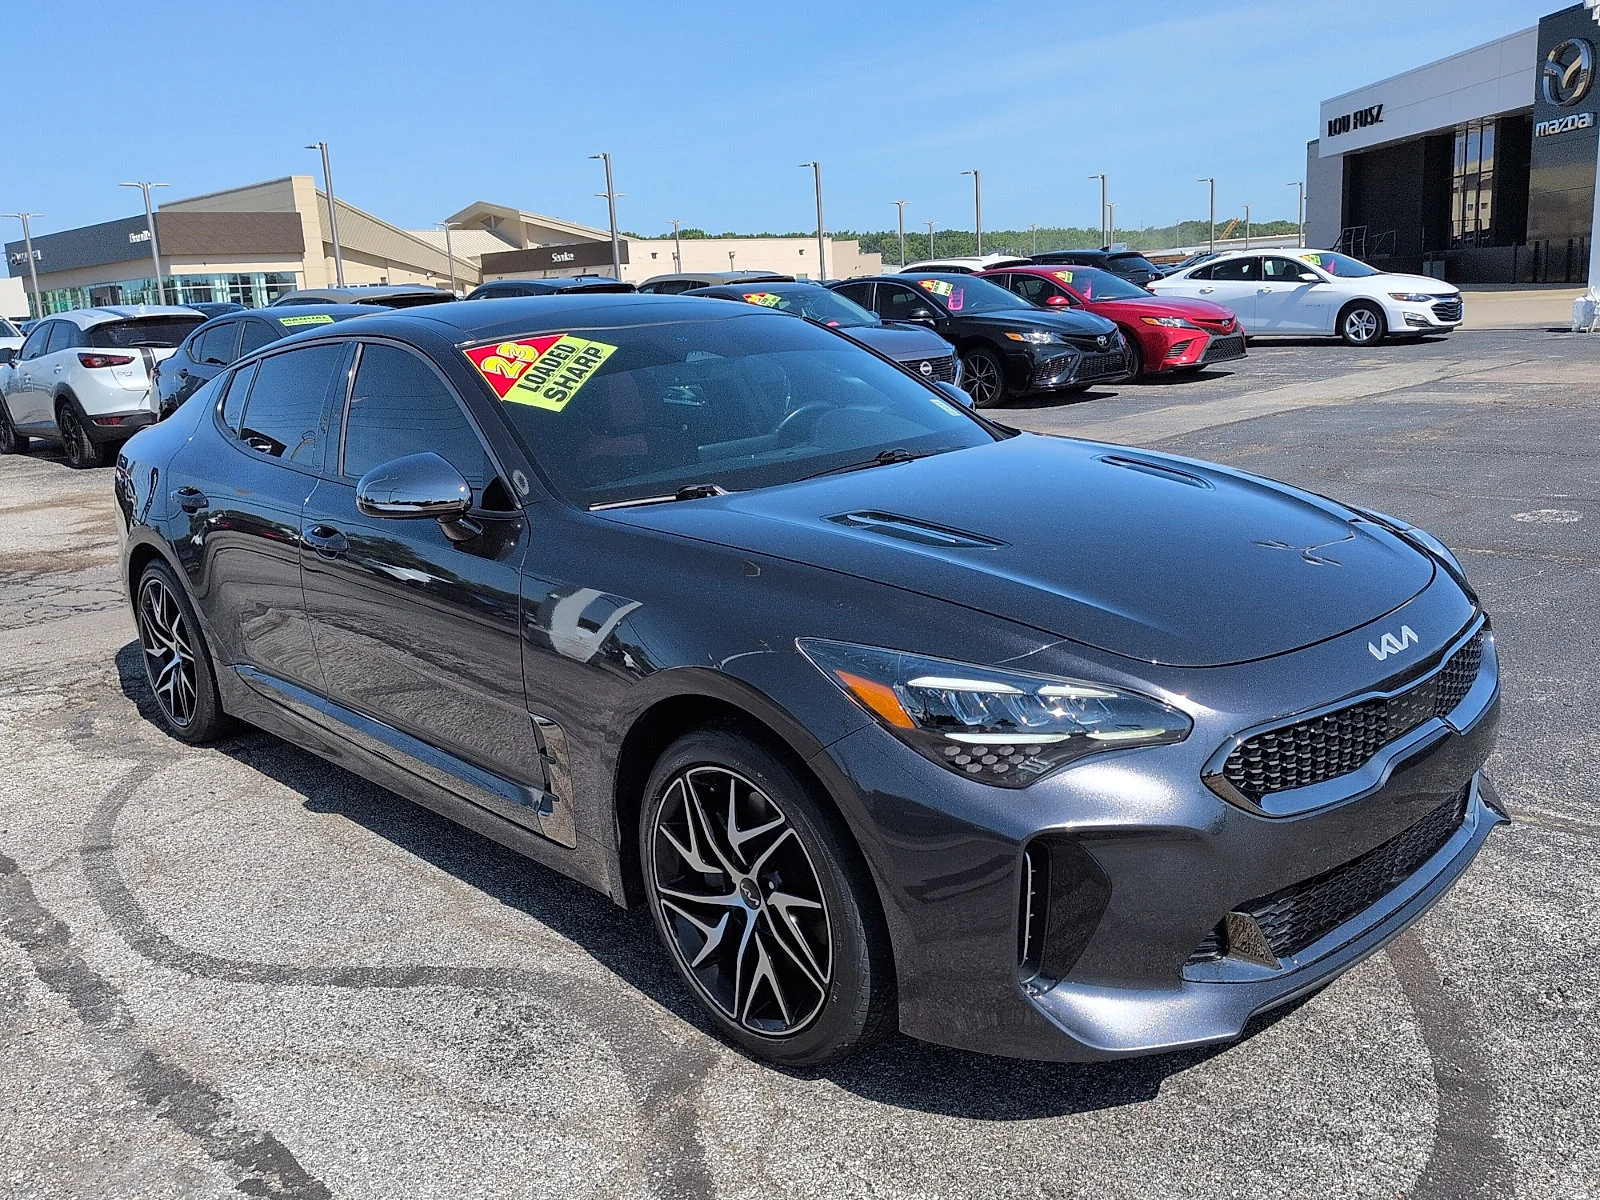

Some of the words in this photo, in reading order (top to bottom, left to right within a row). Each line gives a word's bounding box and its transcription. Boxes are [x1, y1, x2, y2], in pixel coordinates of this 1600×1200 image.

[1327, 114, 1351, 138] LOU
[1352, 103, 1384, 130] FUSZ
[480, 341, 540, 380] 23
[516, 343, 578, 393] LOADED
[542, 346, 603, 403] SHARP
[1367, 624, 1419, 661] KIA
